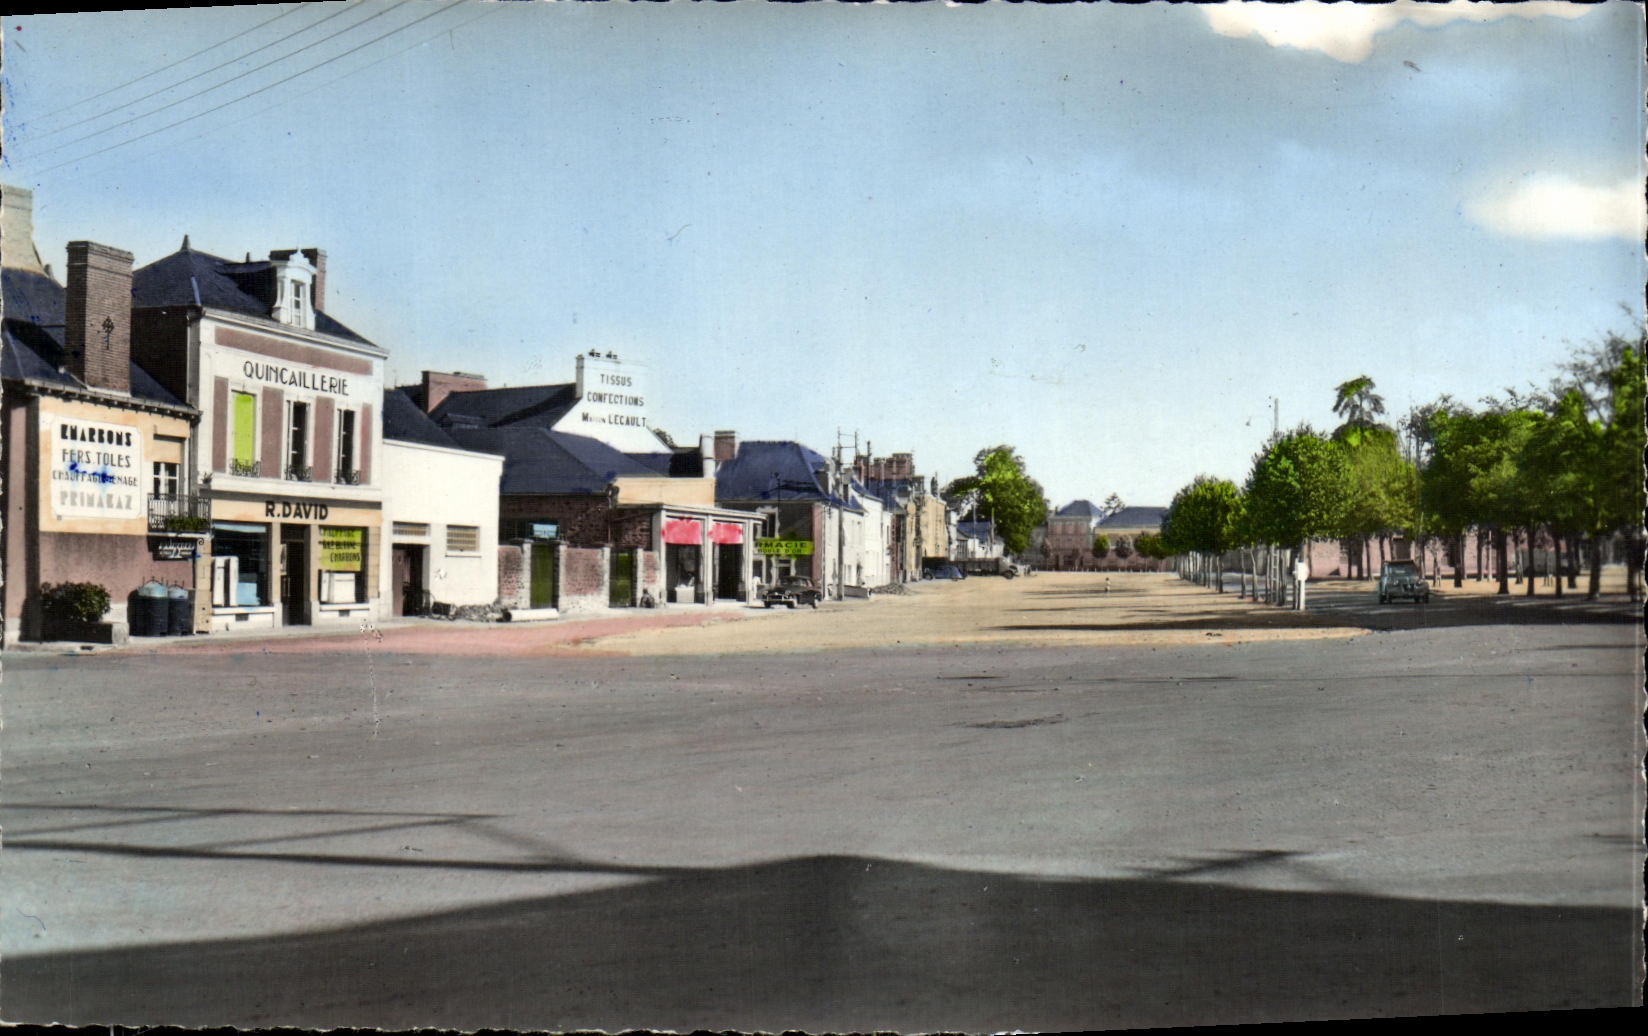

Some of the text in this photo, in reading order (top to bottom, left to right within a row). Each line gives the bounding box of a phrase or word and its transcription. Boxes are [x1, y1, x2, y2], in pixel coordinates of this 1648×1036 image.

[243, 361, 349, 396] QUINCAILLERIE
[600, 373, 632, 387] TISSUS
[587, 391, 645, 407] CONFECTIONS
[608, 414, 647, 428] LECAULT
[60, 423, 132, 447] CHARBONS
[96, 451, 131, 468] TOLES
[103, 474, 138, 487] ENAGE
[60, 490, 133, 510] PRIMAGAZ
